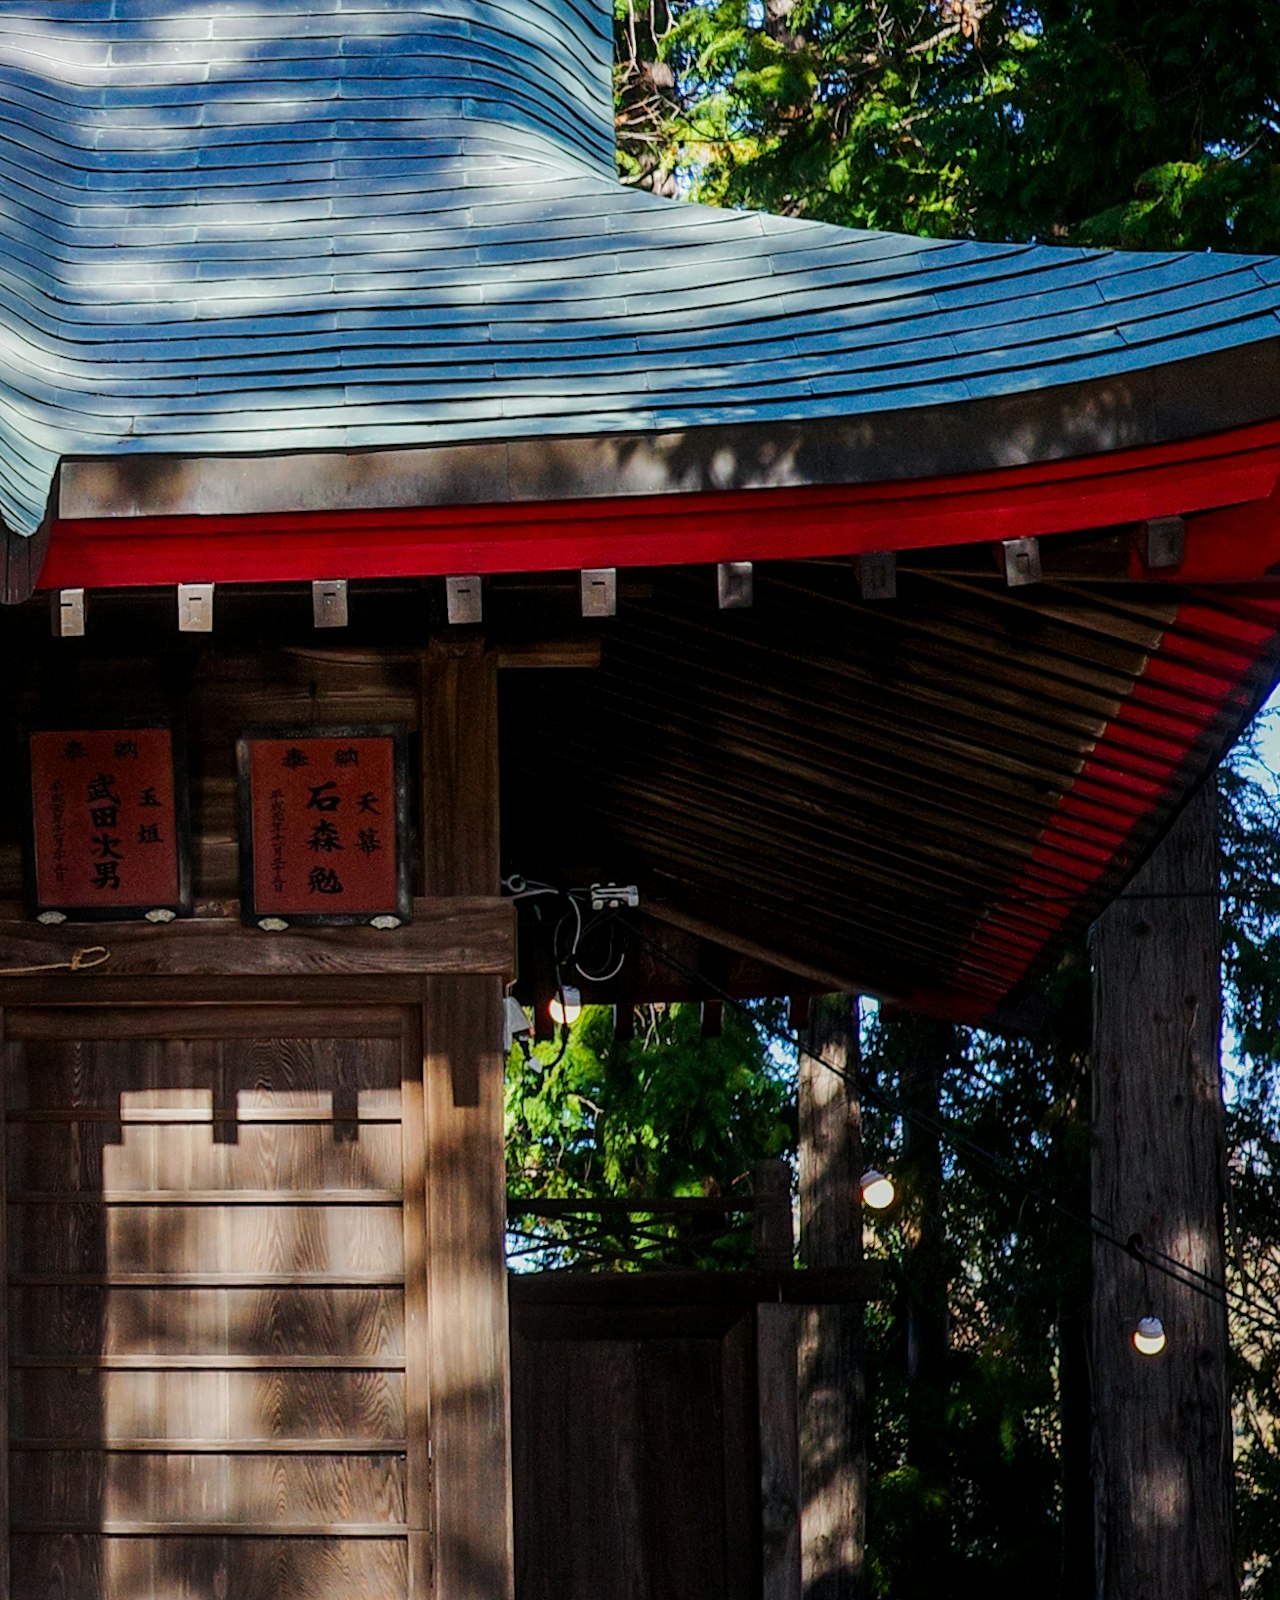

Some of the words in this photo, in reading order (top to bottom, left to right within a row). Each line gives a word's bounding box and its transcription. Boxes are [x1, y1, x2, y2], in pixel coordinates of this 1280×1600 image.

[86, 772, 124, 890] 武田次男
[306, 780, 346, 894] 石森勉
